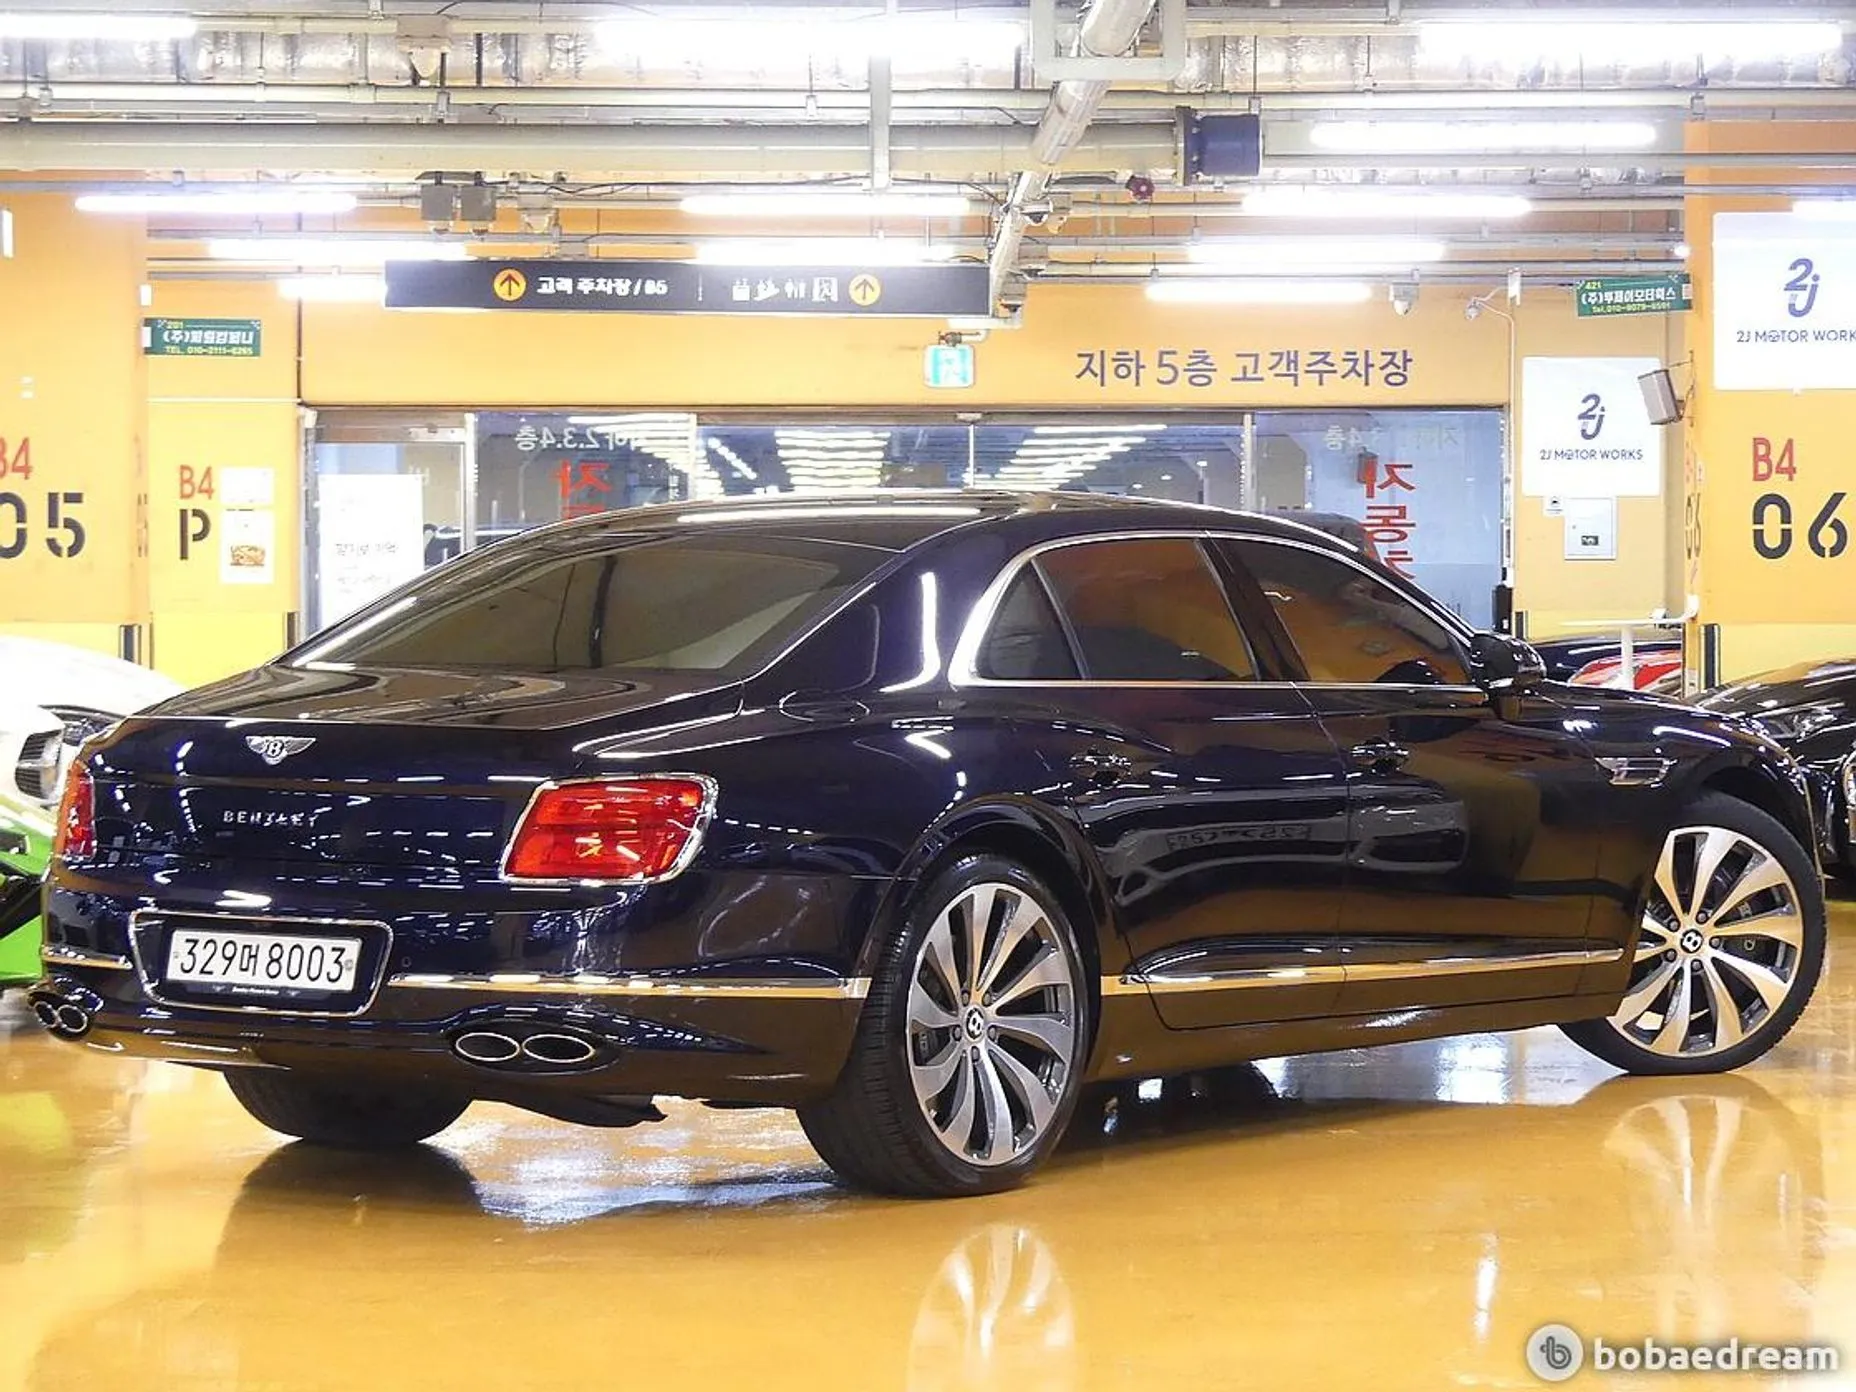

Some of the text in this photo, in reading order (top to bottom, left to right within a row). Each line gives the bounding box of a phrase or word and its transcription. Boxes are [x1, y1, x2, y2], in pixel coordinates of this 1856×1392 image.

[1075, 350, 1413, 387] 지하 5층 고객주차장
[1600, 449, 1643, 460] WORKS
[1752, 437, 1797, 481] B4
[179, 465, 215, 500] B4
[0, 492, 86, 559] 05
[179, 508, 211, 560] P
[1752, 492, 1848, 560] 06
